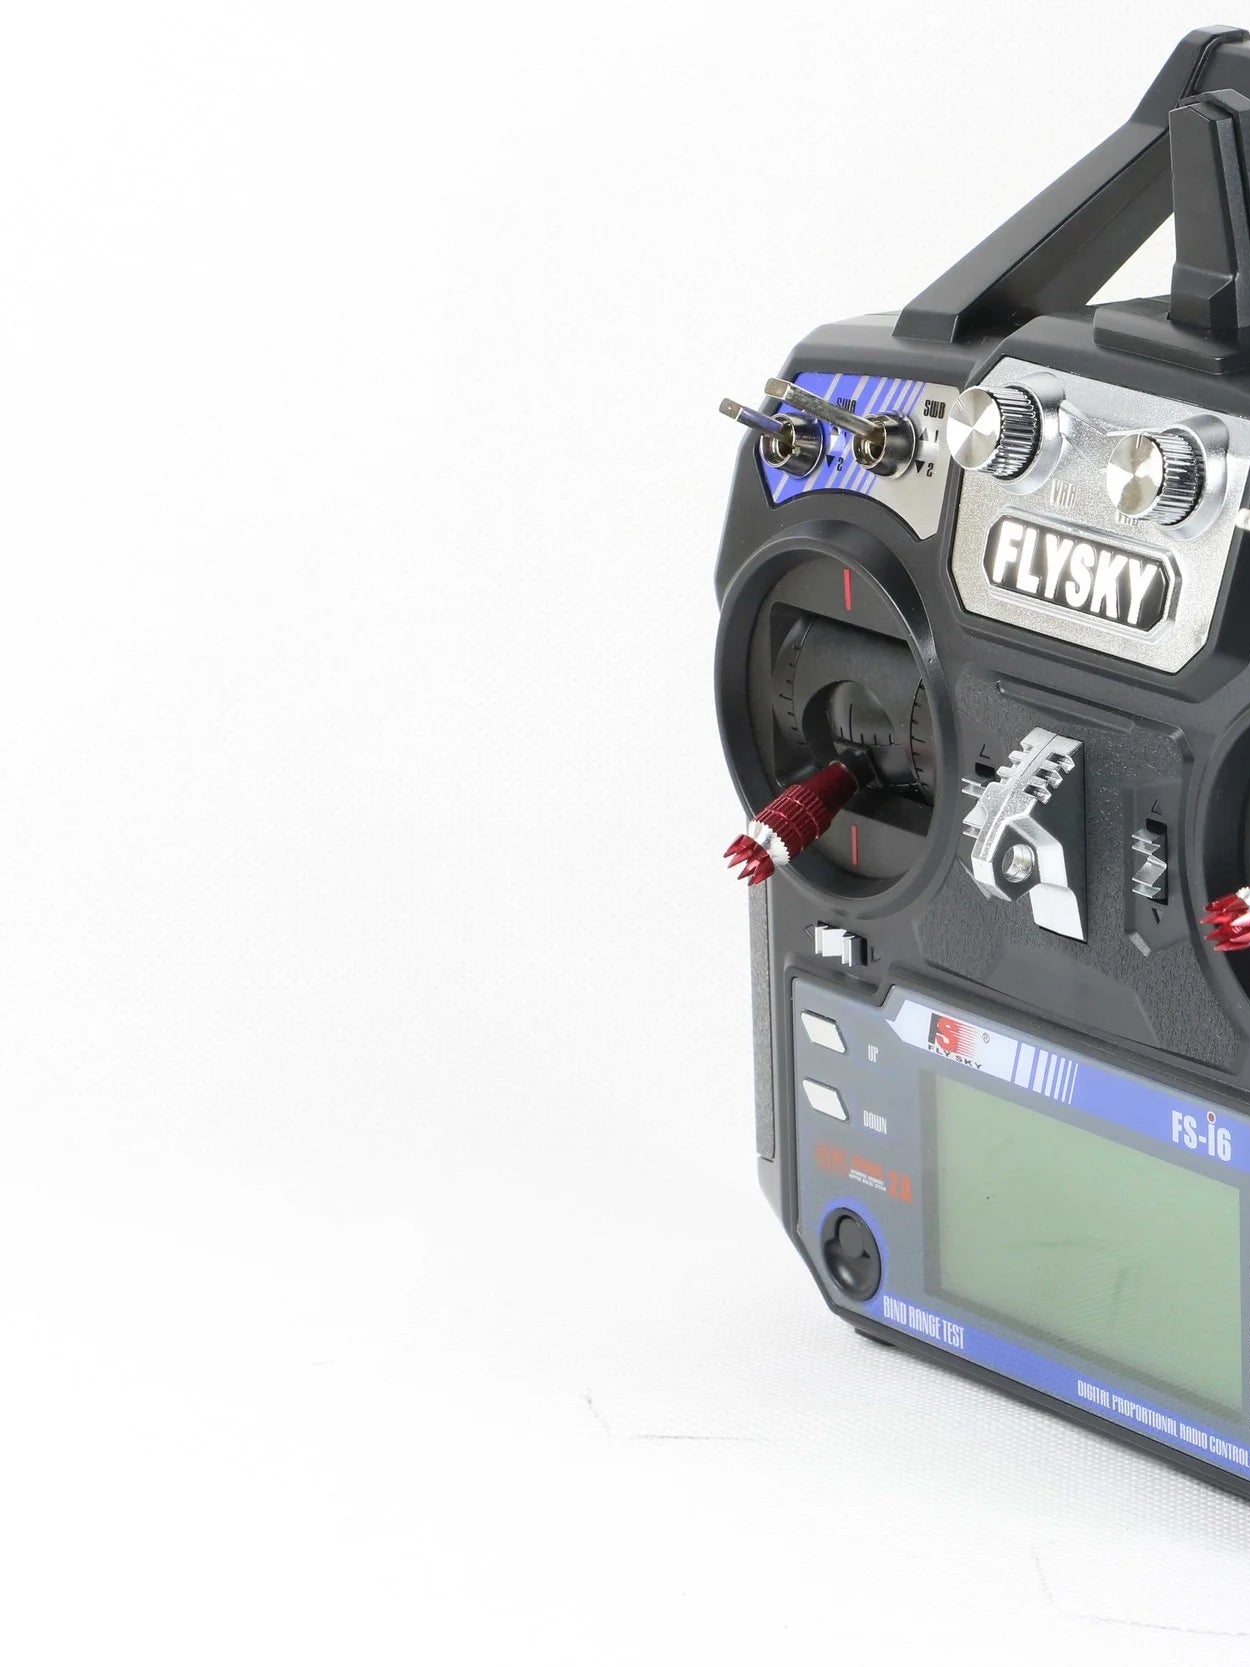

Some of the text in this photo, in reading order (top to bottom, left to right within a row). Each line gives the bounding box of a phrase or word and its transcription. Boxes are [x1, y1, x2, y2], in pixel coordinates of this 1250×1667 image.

[923, 399, 946, 419] SWB
[926, 462, 934, 478] 2
[991, 520, 1159, 626] FLYSKY
[867, 1044, 879, 1063] UP
[928, 1044, 982, 1070] FLY SKY
[863, 1110, 888, 1135] DOWN
[1171, 1110, 1233, 1162] FS-i6
[883, 1295, 965, 1350] BIND RANGE TEST
[1077, 1379, 1111, 1409] DIGITAL
[1111, 1394, 1178, 1438] PROPORTIONAL
[1179, 1422, 1208, 1450] RADIO
[1209, 1435, 1250, 1468] CONTROL
